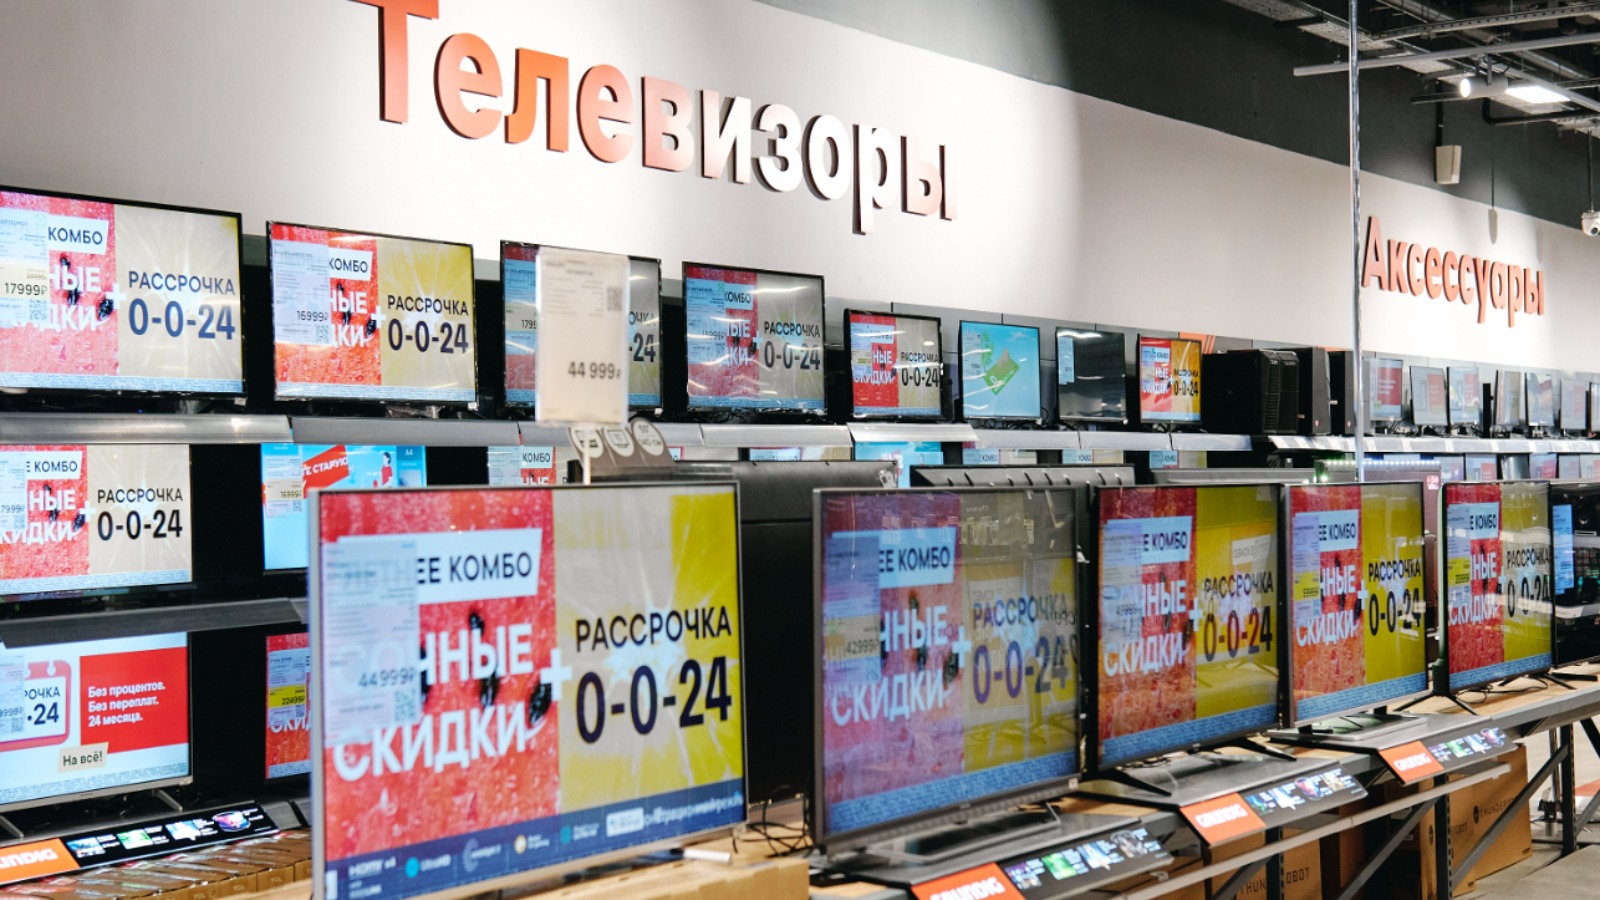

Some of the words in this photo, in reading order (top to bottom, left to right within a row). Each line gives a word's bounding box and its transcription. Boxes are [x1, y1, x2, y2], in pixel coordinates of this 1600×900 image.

[350, 0, 958, 235] Телевизоры
[47, 226, 103, 245] КОМБО
[128, 270, 236, 295] РАССРОЧКА
[1361, 216, 1544, 328] Аксессуары
[387, 294, 469, 316] РАССРОЧКА
[128, 298, 236, 340] 0-0-24
[764, 321, 820, 338] РАССРОЧКА
[387, 318, 469, 354] 0-0-24
[764, 341, 821, 371] 0-0-24
[568, 362, 586, 379] 44
[901, 367, 939, 387] 0-0-24
[34, 460, 78, 473] КОМБО
[522, 452, 550, 463] КОМБО
[97, 488, 184, 504] РАССРОЧКА
[97, 508, 184, 541] 0-0-24
[1329, 523, 1356, 540] КОМБО
[1475, 514, 1497, 529] КОМБО
[1152, 531, 1187, 550] КОМБО
[450, 552, 532, 582] КОМБО
[898, 546, 950, 572] КОМБО
[1368, 559, 1422, 582] РАССРОЧКА
[1204, 570, 1274, 601] РАССРОЧКА
[1369, 588, 1422, 636] 0-0-24
[576, 606, 732, 653] РАССРОЧКА
[1204, 605, 1273, 663] 0-0-24
[973, 634, 1069, 705] 0-0-24
[88, 686, 107, 698] Без
[109, 681, 165, 696] процентов.
[576, 656, 732, 744] 0-0-24
[88, 701, 107, 712] Без
[109, 696, 159, 711] переплат.
[88, 716, 101, 727] 24
[103, 712, 143, 725] месяца.
[63, 755, 77, 766] На
[80, 751, 103, 763] всё!
[1194, 803, 1248, 829] GRUNDIG
